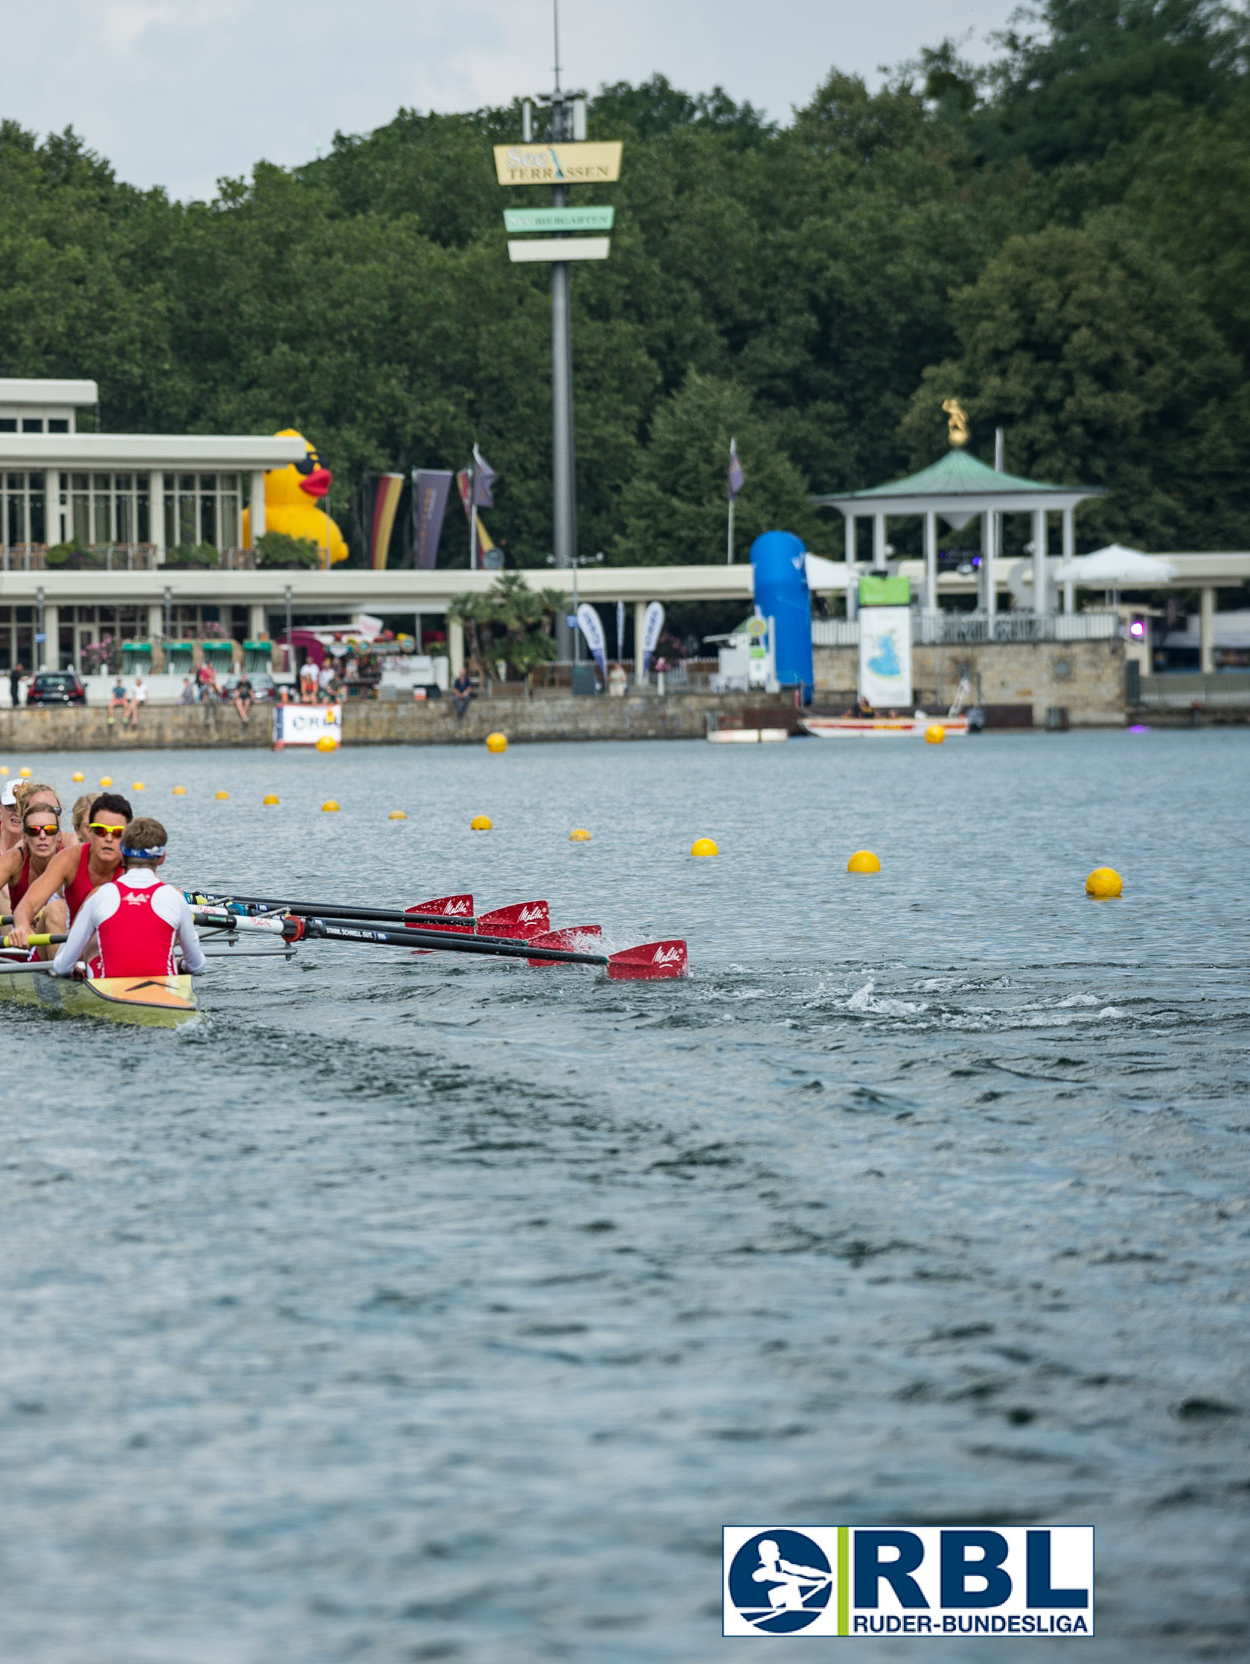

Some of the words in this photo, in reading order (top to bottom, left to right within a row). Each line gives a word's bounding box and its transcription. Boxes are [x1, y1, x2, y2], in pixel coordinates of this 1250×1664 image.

[507, 146, 548, 168] See
[516, 906, 545, 923] Melitta
[651, 946, 680, 964] Melitta
